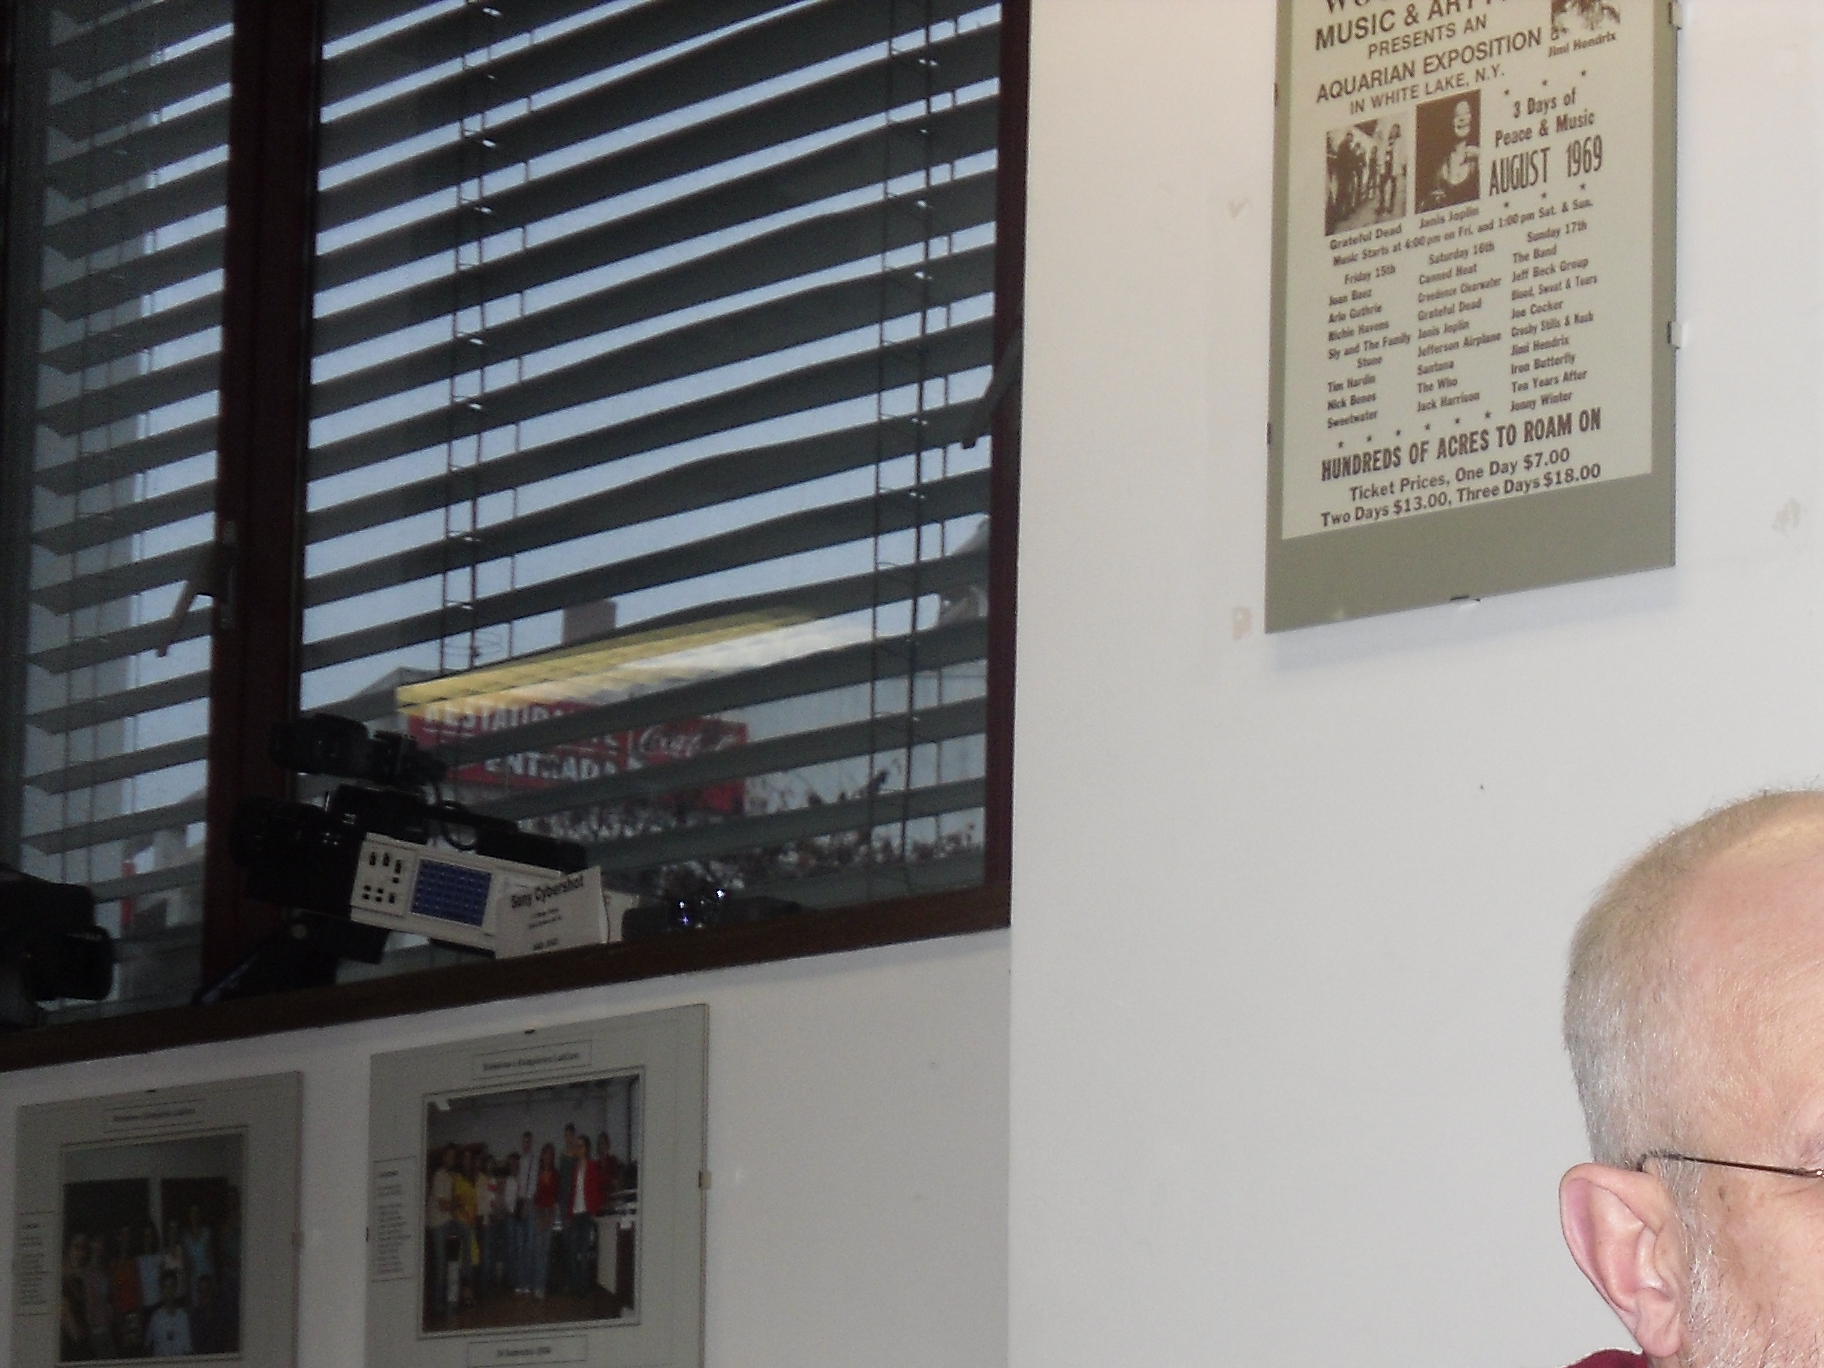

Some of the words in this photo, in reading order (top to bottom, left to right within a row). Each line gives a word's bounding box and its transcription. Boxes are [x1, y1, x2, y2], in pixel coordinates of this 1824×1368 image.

[1316, 9, 1396, 50] MUSIC
[1404, 3, 1419, 26] &
[1368, 22, 1456, 59] PRESENTS
[1463, 14, 1487, 34] AN
[1316, 60, 1416, 103] AQUARIAN
[1423, 26, 1542, 74] EXPOSITION
[1350, 98, 1365, 114] IN
[1370, 84, 1420, 109] WHITE
[1425, 72, 1469, 95] LAKE,
[1475, 63, 1505, 83] N.Y.
[1513, 100, 1520, 119] 3
[1527, 96, 1557, 115] Days
[1563, 86, 1576, 106] of
[1495, 127, 1532, 148] Peace
[1539, 118, 1548, 137] &
[1556, 108, 1595, 133] Music
[1489, 146, 1550, 197] AUGUST
[1566, 134, 1602, 178] 1969
[1330, 231, 1372, 250] Grateful
[1375, 222, 1402, 239] Dead
[1333, 252, 1358, 266] Music
[1362, 245, 1389, 260] Starts
[1477, 219, 1494, 233] and
[1561, 201, 1569, 213] &
[1527, 228, 1561, 243] Sunday
[1565, 219, 1588, 234] 17th
[1429, 247, 1469, 265] Saturday
[1512, 252, 1529, 264] The
[1533, 243, 1557, 259] Band
[1344, 272, 1372, 285] Friday
[1375, 264, 1396, 278] 15th
[1456, 263, 1477, 276] Heat
[1512, 268, 1529, 283] Jeff
[1533, 263, 1556, 277] Beck
[1560, 258, 1589, 272] Group
[1565, 278, 1571, 289] &
[1575, 275, 1598, 287] Tears
[1350, 303, 1382, 319] Guthrie
[1418, 303, 1455, 320] Grateful
[1459, 297, 1482, 312] Dead
[1511, 308, 1527, 319] Joe
[1530, 300, 1563, 315] Cocker
[1564, 315, 1570, 326] &
[1344, 343, 1360, 355] and
[1364, 341, 1380, 351] The
[1382, 332, 1411, 347] Family
[1418, 341, 1459, 357] Jefferson
[1463, 333, 1501, 347] Airplane
[1533, 335, 1569, 351] Hendrix
[1511, 362, 1530, 375] Iron
[1534, 352, 1576, 370] Butterfly
[1417, 382, 1433, 393] The
[1438, 377, 1458, 389] Who
[1511, 381, 1529, 393] Ten
[1533, 376, 1559, 388] Years
[1563, 370, 1587, 382] After
[1417, 400, 1437, 412] Jack
[1541, 391, 1572, 405] Winter
[1321, 445, 1402, 481] HUNDREDS
[1409, 440, 1429, 465] OF
[1437, 428, 1489, 460] ACRES
[1496, 423, 1517, 448] TO
[1523, 412, 1572, 443] ROAM
[1579, 406, 1601, 432] ON
[1349, 481, 1395, 501] Ticket
[1400, 474, 1450, 493] Prices,
[1455, 466, 1484, 482] One
[1489, 459, 1518, 476] Day
[1523, 447, 1570, 471] $7.00
[1320, 511, 1351, 527] Two
[1355, 505, 1389, 521] Days
[1456, 483, 1500, 503] Three
[1504, 476, 1541, 494] Days
[1543, 462, 1601, 487] $18.00
